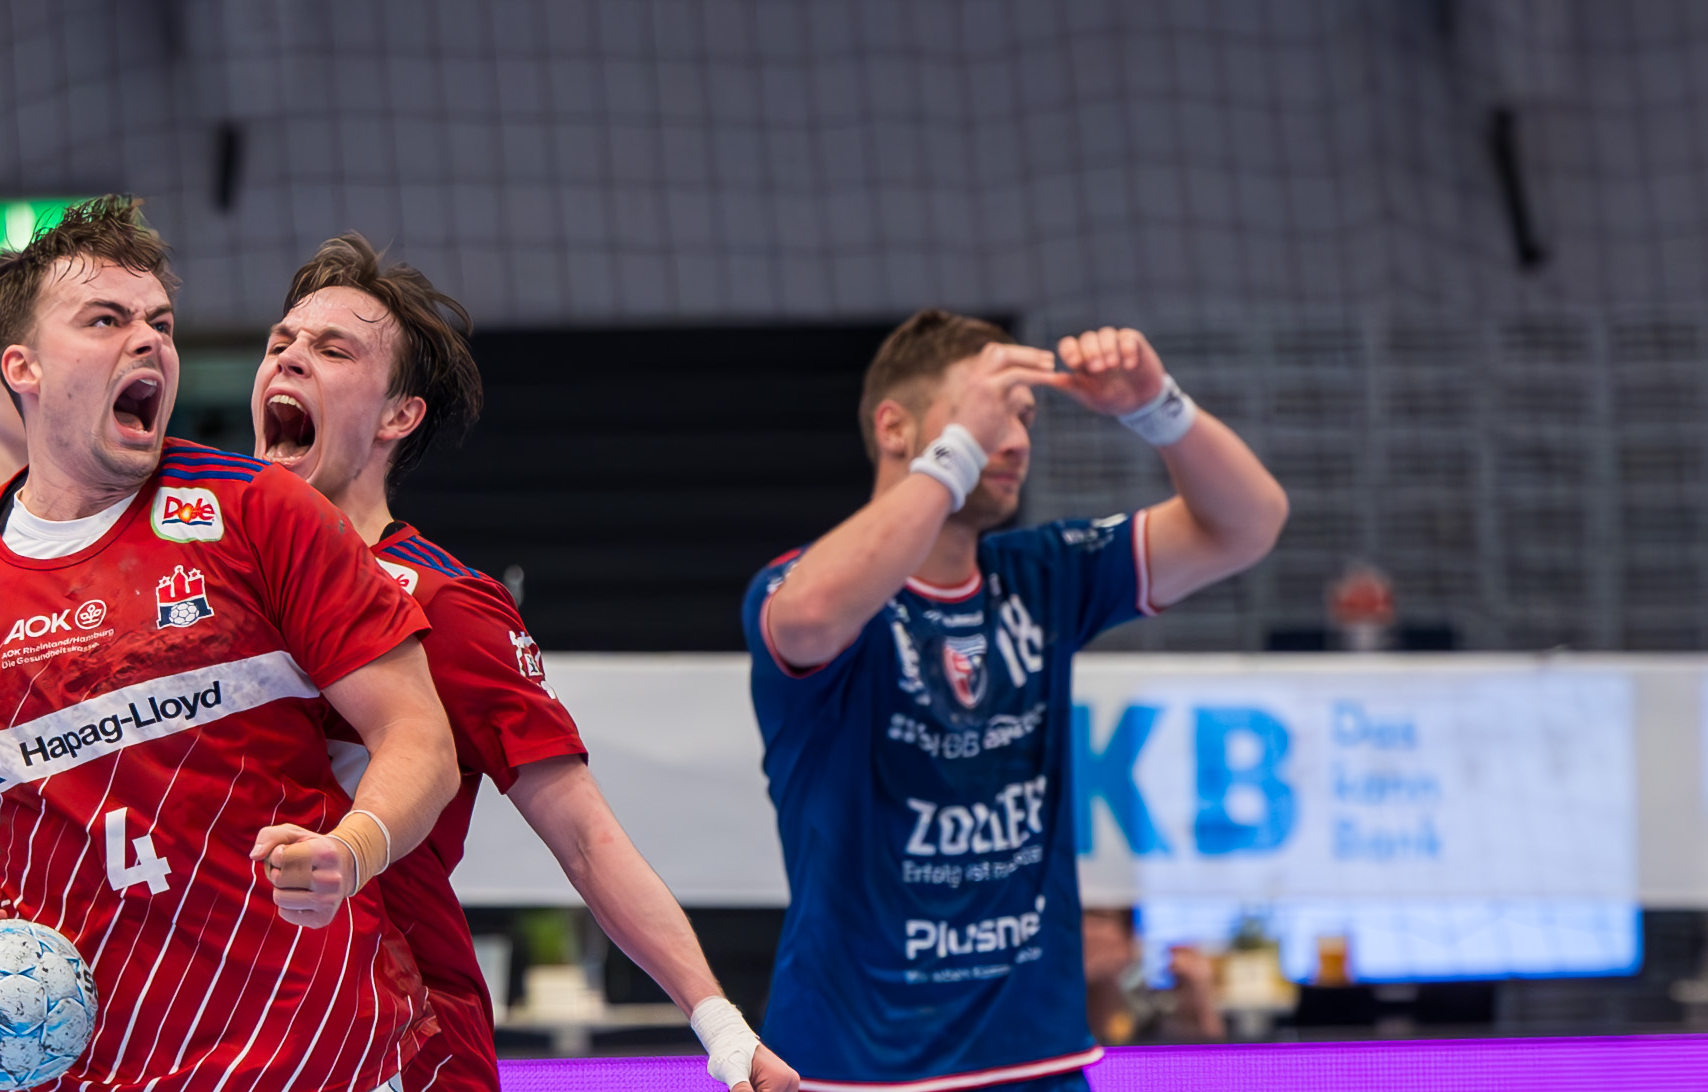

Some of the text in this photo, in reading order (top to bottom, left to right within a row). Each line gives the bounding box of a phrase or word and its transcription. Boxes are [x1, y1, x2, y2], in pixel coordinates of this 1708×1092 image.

[163, 496, 216, 521] Dole
[4, 608, 72, 645] AOK
[1, 648, 22, 660] AOK
[1, 656, 16, 670] Die
[19, 680, 222, 767] Hapag-Lloyd
[105, 806, 173, 896] 4
